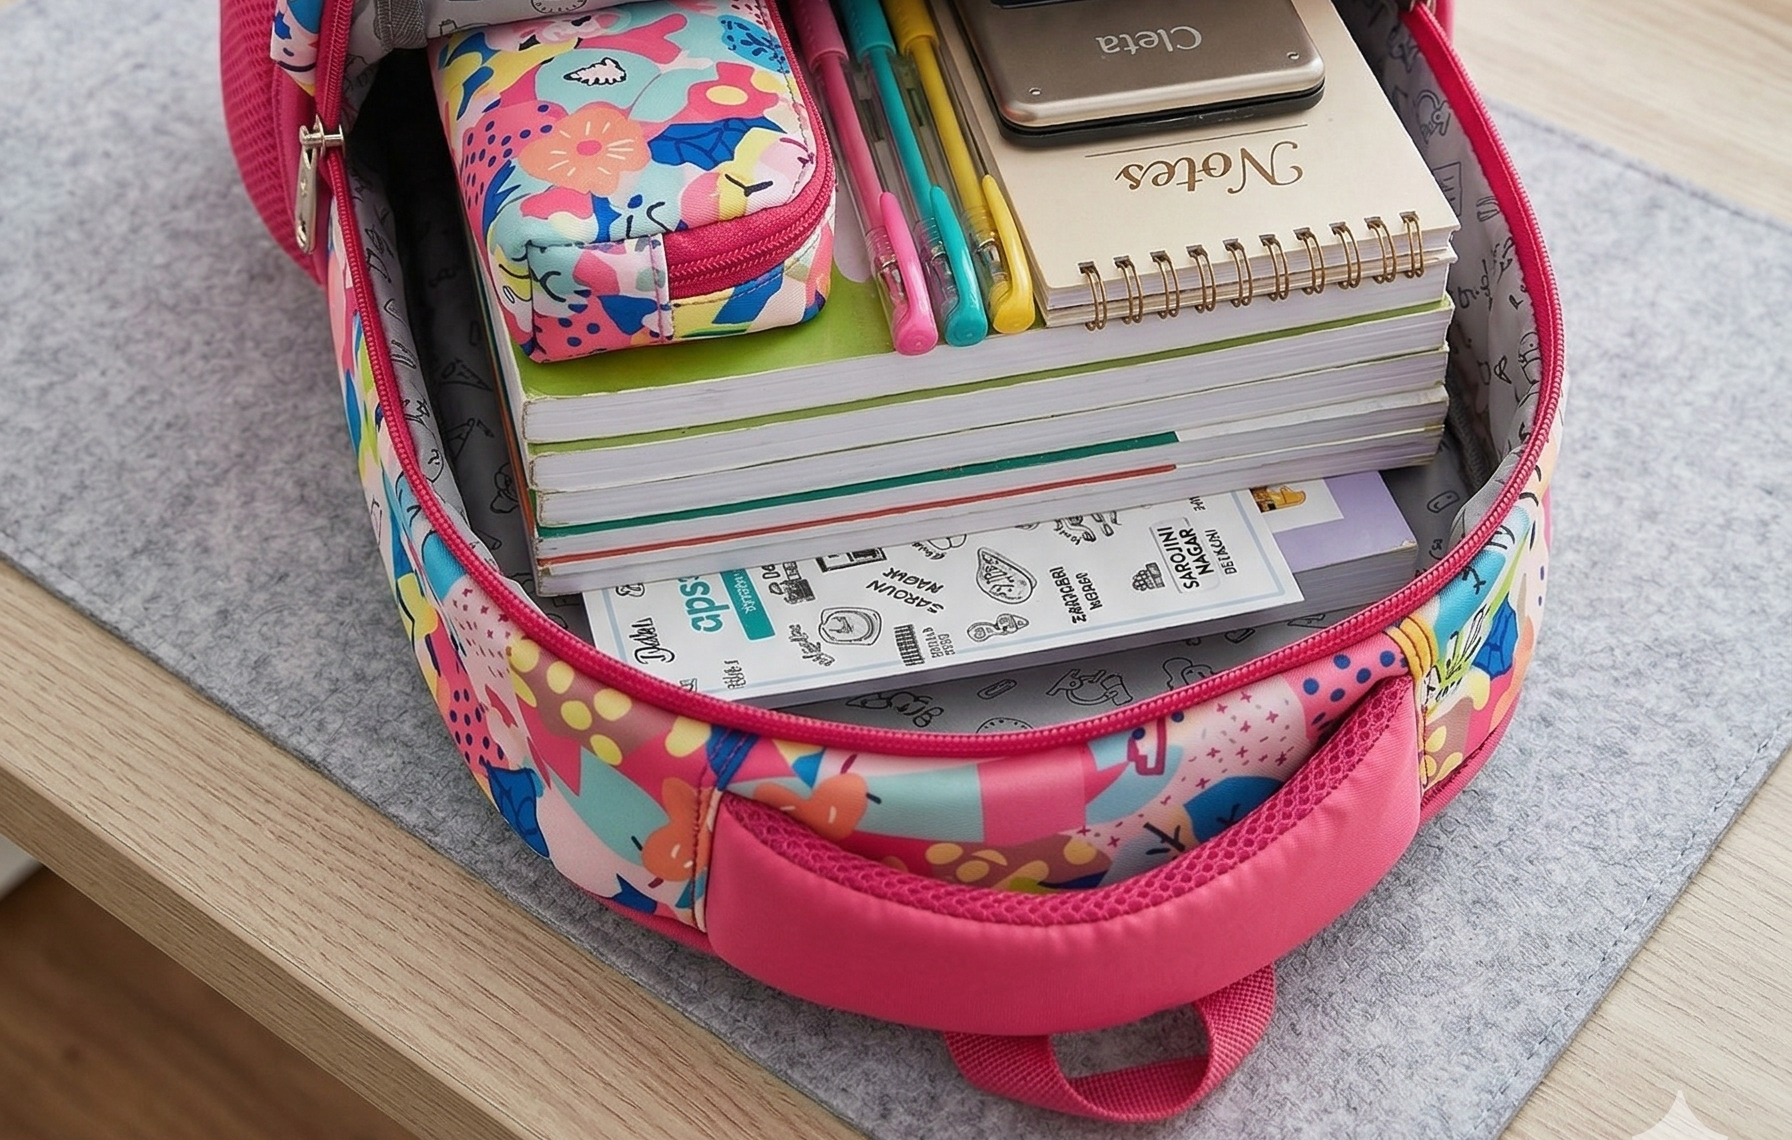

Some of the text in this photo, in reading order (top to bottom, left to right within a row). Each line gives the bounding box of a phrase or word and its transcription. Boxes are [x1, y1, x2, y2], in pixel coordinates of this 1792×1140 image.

[1096, 25, 1202, 55] Cleta
[1115, 140, 1304, 195] Notes
[1157, 526, 1199, 589] SAROJINI
[1179, 527, 1214, 575] NAGAR
